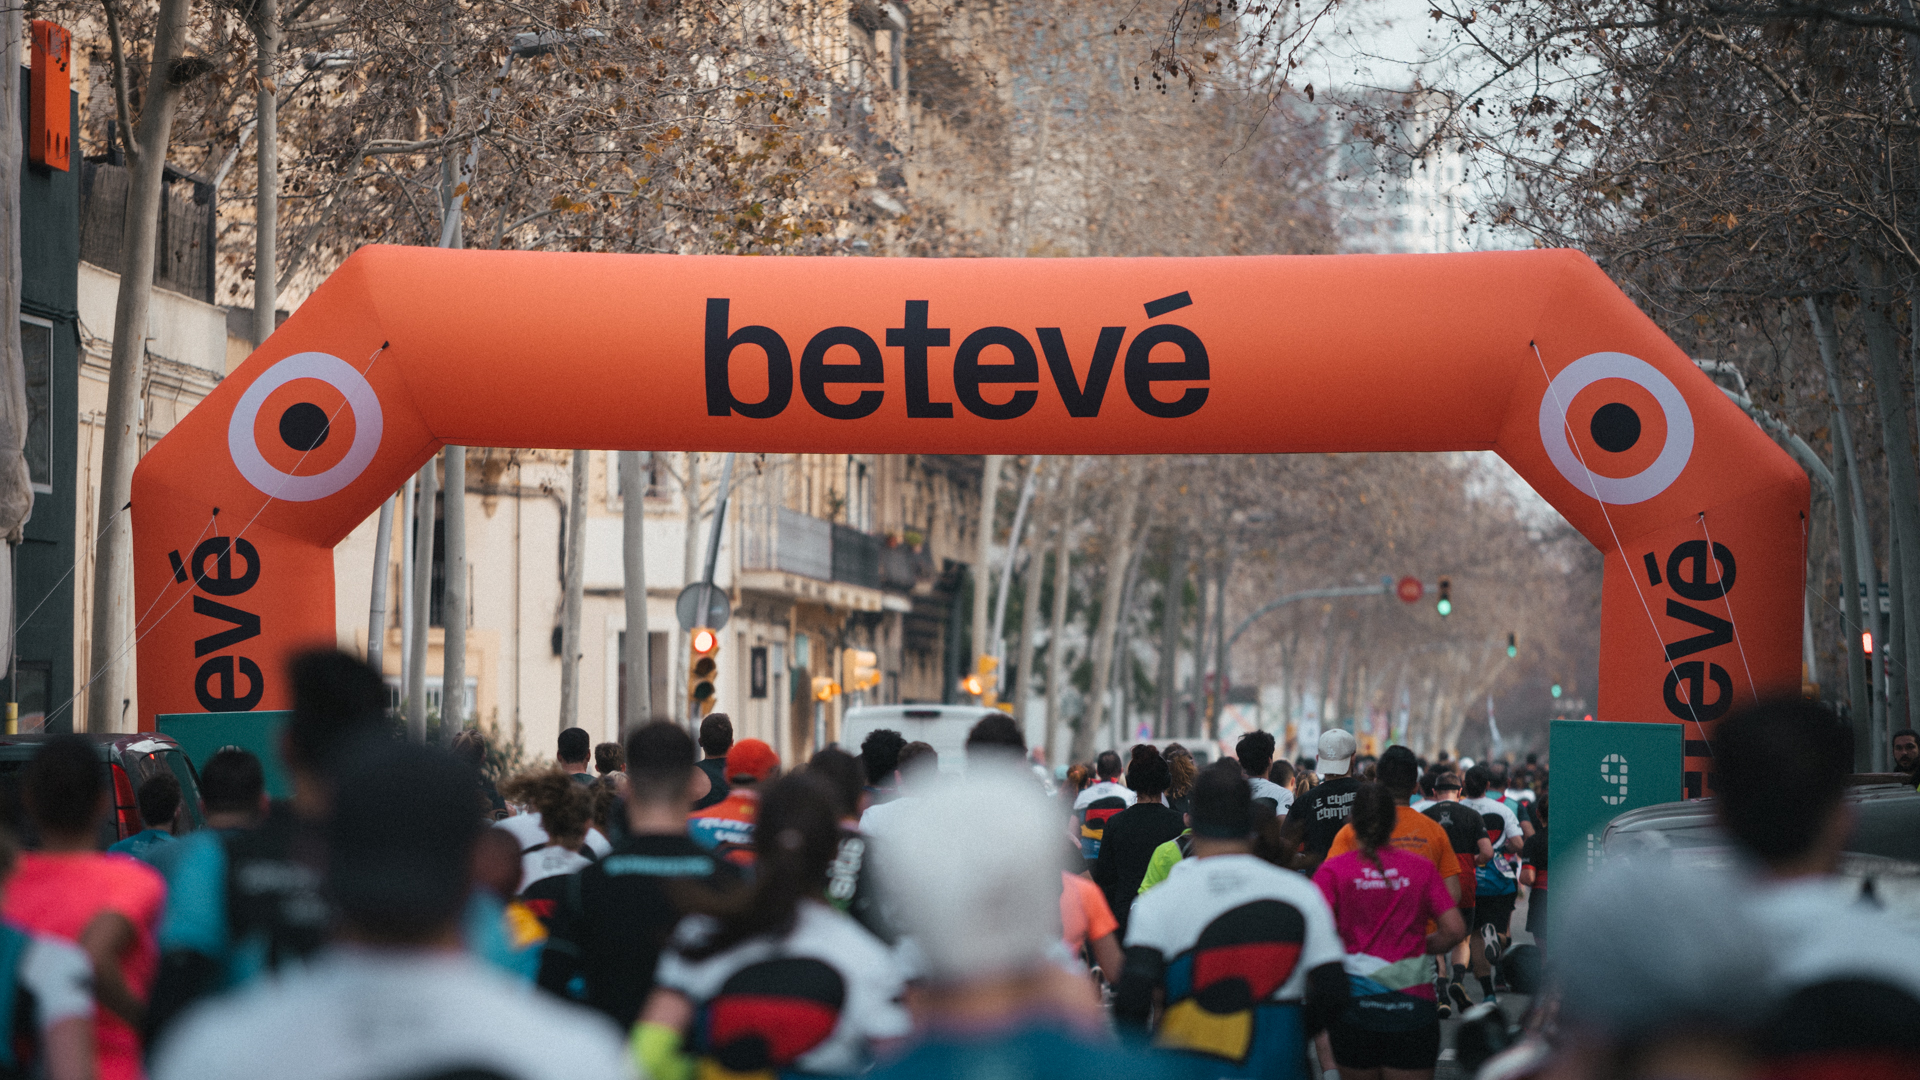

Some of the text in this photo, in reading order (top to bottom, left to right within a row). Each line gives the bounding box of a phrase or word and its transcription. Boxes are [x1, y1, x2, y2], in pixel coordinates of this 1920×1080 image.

[704, 290, 1211, 420] betevé
[1643, 540, 1737, 798] evé
[1600, 753, 1629, 806] 9
